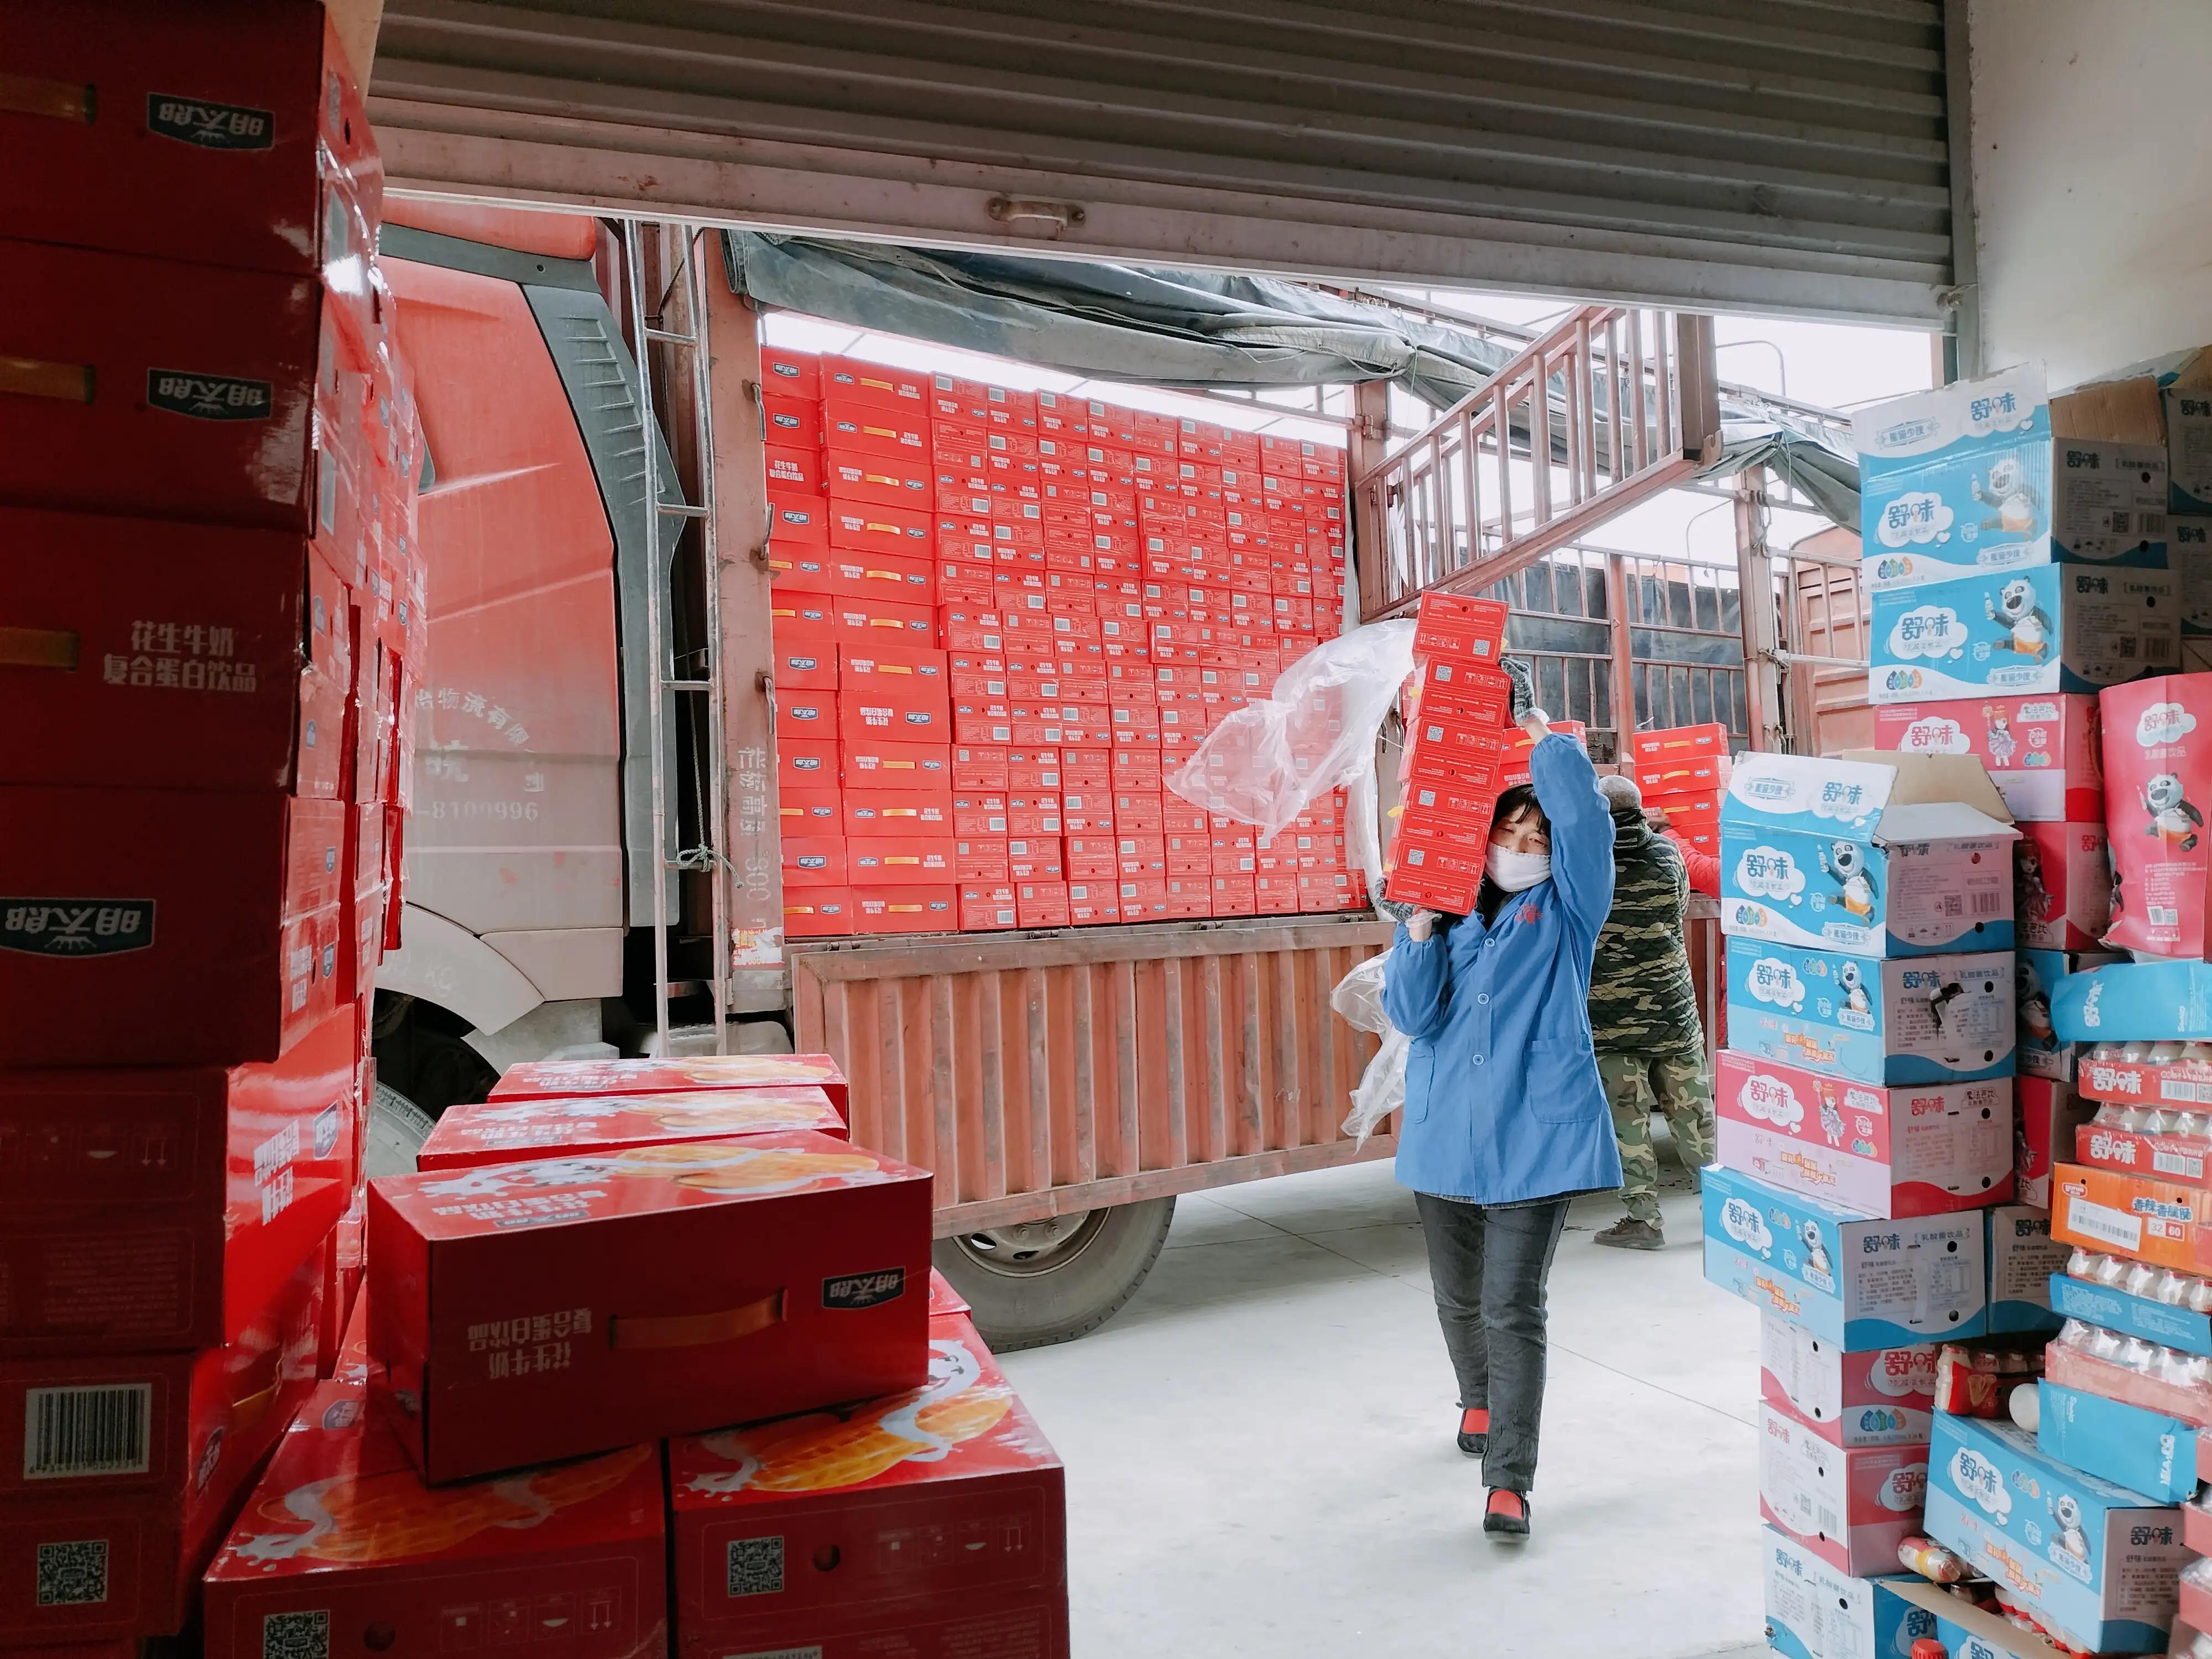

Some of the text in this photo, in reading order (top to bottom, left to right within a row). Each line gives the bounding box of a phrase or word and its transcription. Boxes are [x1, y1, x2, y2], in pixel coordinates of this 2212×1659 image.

[159, 102, 265, 136] 明太郎
[158, 377, 265, 406] 明太郎
[1970, 392, 2017, 421] 舒味
[2067, 450, 2100, 469] 舒味
[1887, 502, 1935, 529] 舒味
[2075, 575, 2110, 594] 舒味
[131, 619, 234, 658] 花生牛奶
[1901, 612, 1950, 640] 舒味
[103, 653, 257, 694] 复合蛋白饮品
[2143, 710, 2182, 732] 舒味
[1911, 724, 1954, 747] 舒味
[1822, 781, 1863, 806] 舒味
[1746, 853, 1790, 880] 舒味
[4, 905, 143, 935] 明太郎
[1756, 963, 1792, 989] 舒味
[1902, 970, 1942, 989] 舒味
[2093, 1067, 2142, 1095] 舒味
[1749, 1081, 1789, 1110] 舒味
[1911, 1096, 1945, 1117] 舒味
[2090, 1134, 2137, 1165] 舒味
[1728, 1201, 1761, 1235] 舒味
[2151, 1222, 2182, 1238] 32 60
[1863, 1233, 1900, 1254] 舒味
[1921, 1230, 1963, 1241] 乳酸菌饮品
[830, 1274, 898, 1300] 明太郎
[468, 1307, 592, 1352] 复合蛋白饮品
[488, 1342, 572, 1380] 花生牛奶
[1767, 1417, 1791, 1445] 舒味
[1959, 1452, 1997, 1496] 舒味
[2131, 1526, 2174, 1546] 舒味
[1776, 1547, 1804, 1577] 舒味
